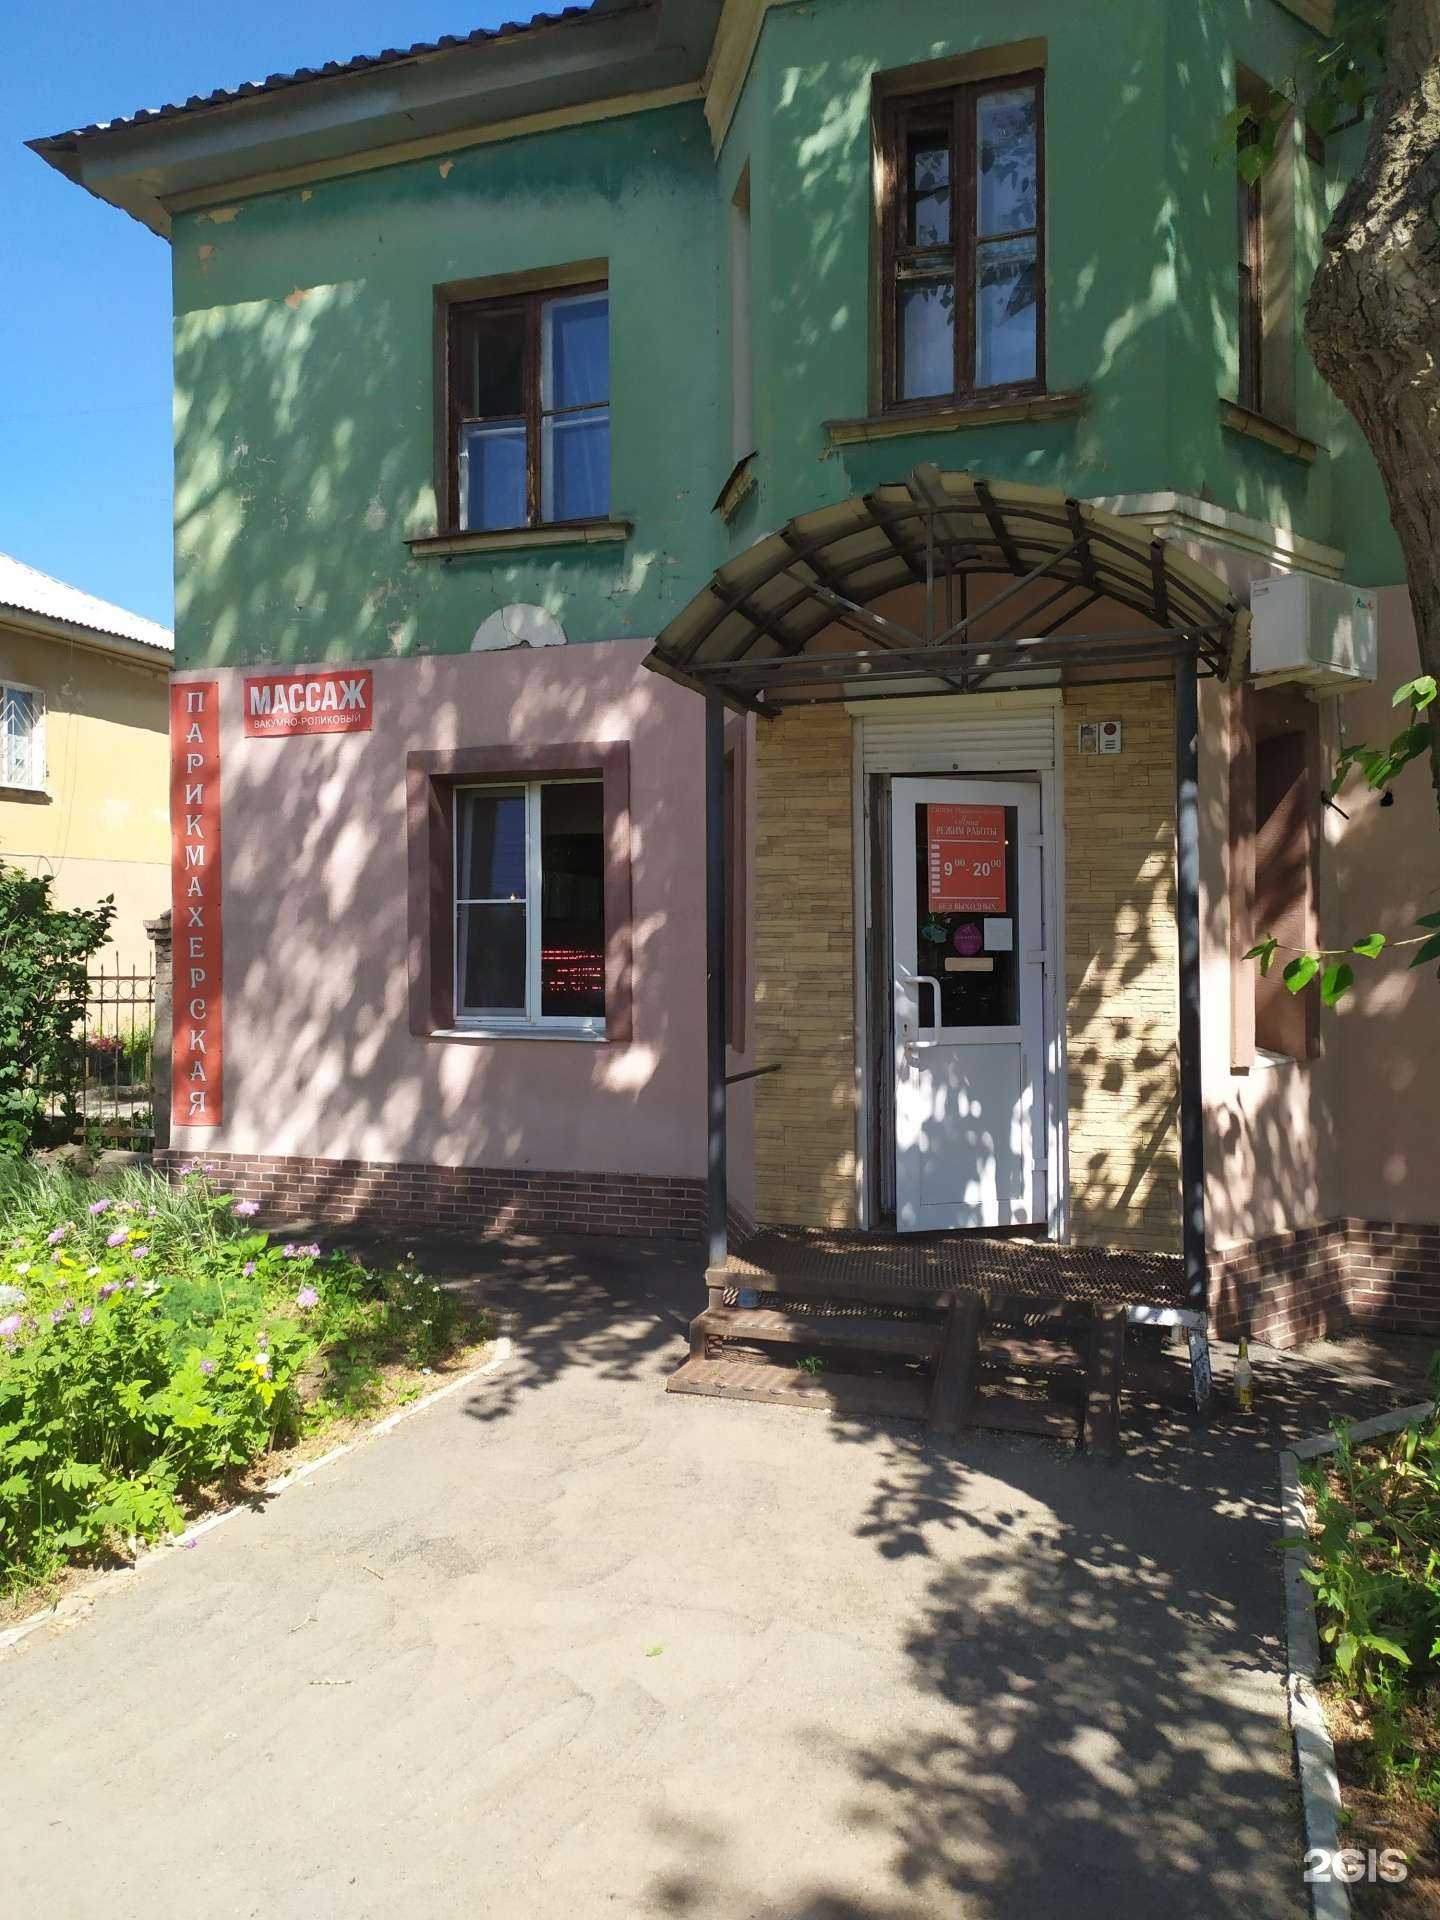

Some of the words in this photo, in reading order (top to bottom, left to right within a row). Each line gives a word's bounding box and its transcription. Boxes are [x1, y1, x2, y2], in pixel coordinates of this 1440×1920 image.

[250, 678, 367, 715] МАССАЖ
[254, 713, 361, 729] ВАКУМНО-РОЛИКОВЫЙ
[936, 825, 965, 836] РЕЖИМ
[966, 826, 997, 837] РАБОТЫ
[944, 862, 953, 876] 9
[973, 862, 991, 877] 20
[185, 691, 207, 1116] ПАРИКМАХЕРСКАЯ
